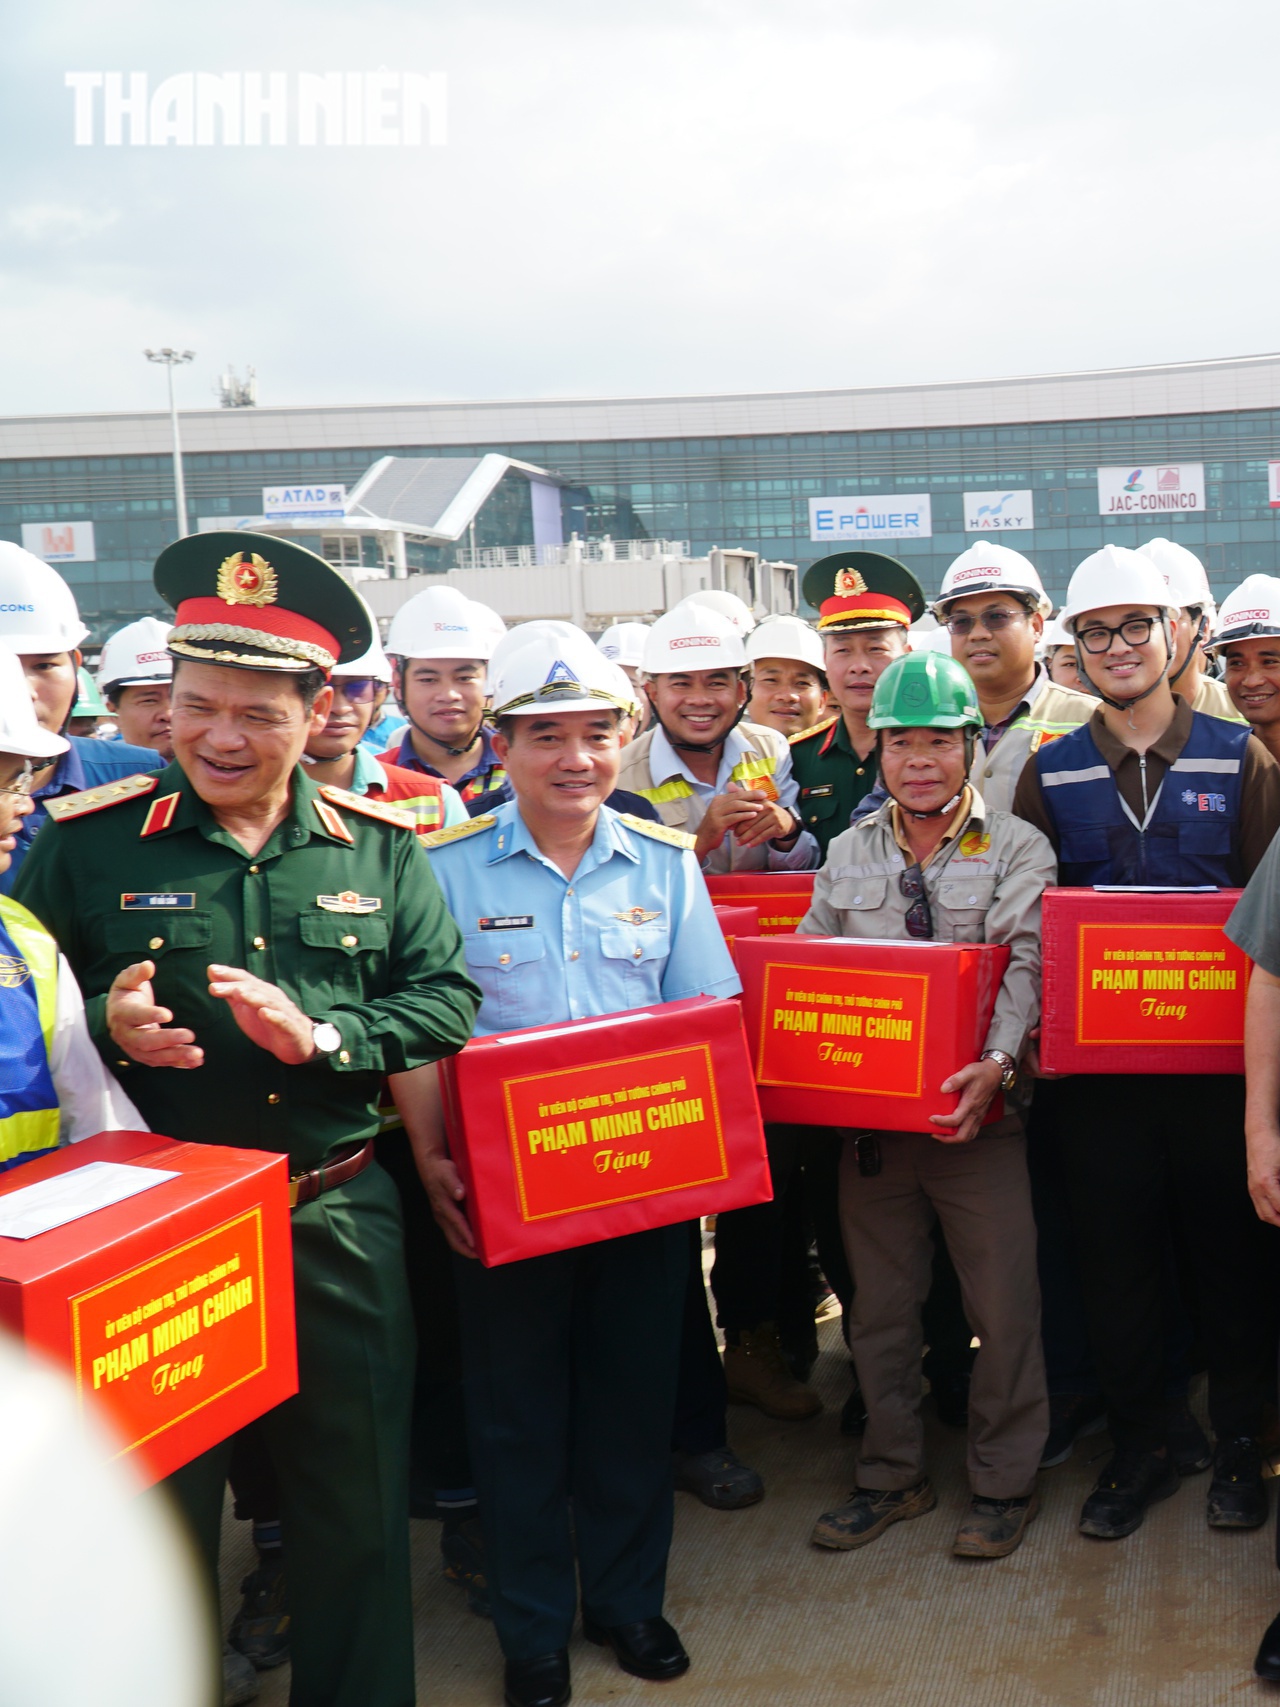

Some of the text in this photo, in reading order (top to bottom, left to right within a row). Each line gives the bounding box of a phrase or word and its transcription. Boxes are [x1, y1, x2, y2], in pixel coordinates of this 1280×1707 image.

[283, 488, 326, 502] ATAD
[1109, 493, 1197, 512] JAC-CONINCO
[970, 517, 1023, 528] HASKY
[816, 531, 857, 540] BUILDING
[954, 567, 1000, 582] CONINCO
[1224, 610, 1269, 625] CONINCO
[670, 637, 720, 650] CONINCO
[1198, 793, 1226, 812] ETC
[1092, 966, 1236, 994] PHẠM MINH CHÍNH
[1140, 998, 1187, 1020] Tặng
[773, 1009, 912, 1041] PHẠM MINH CHÍNH
[817, 1041, 863, 1068] Tặng
[528, 1097, 705, 1155] PHẠM MINH CHÍNH
[593, 1150, 652, 1173] Tặng
[93, 1276, 252, 1390] PHẠM MINH CHÍNH
[152, 1354, 205, 1395] Tặng
